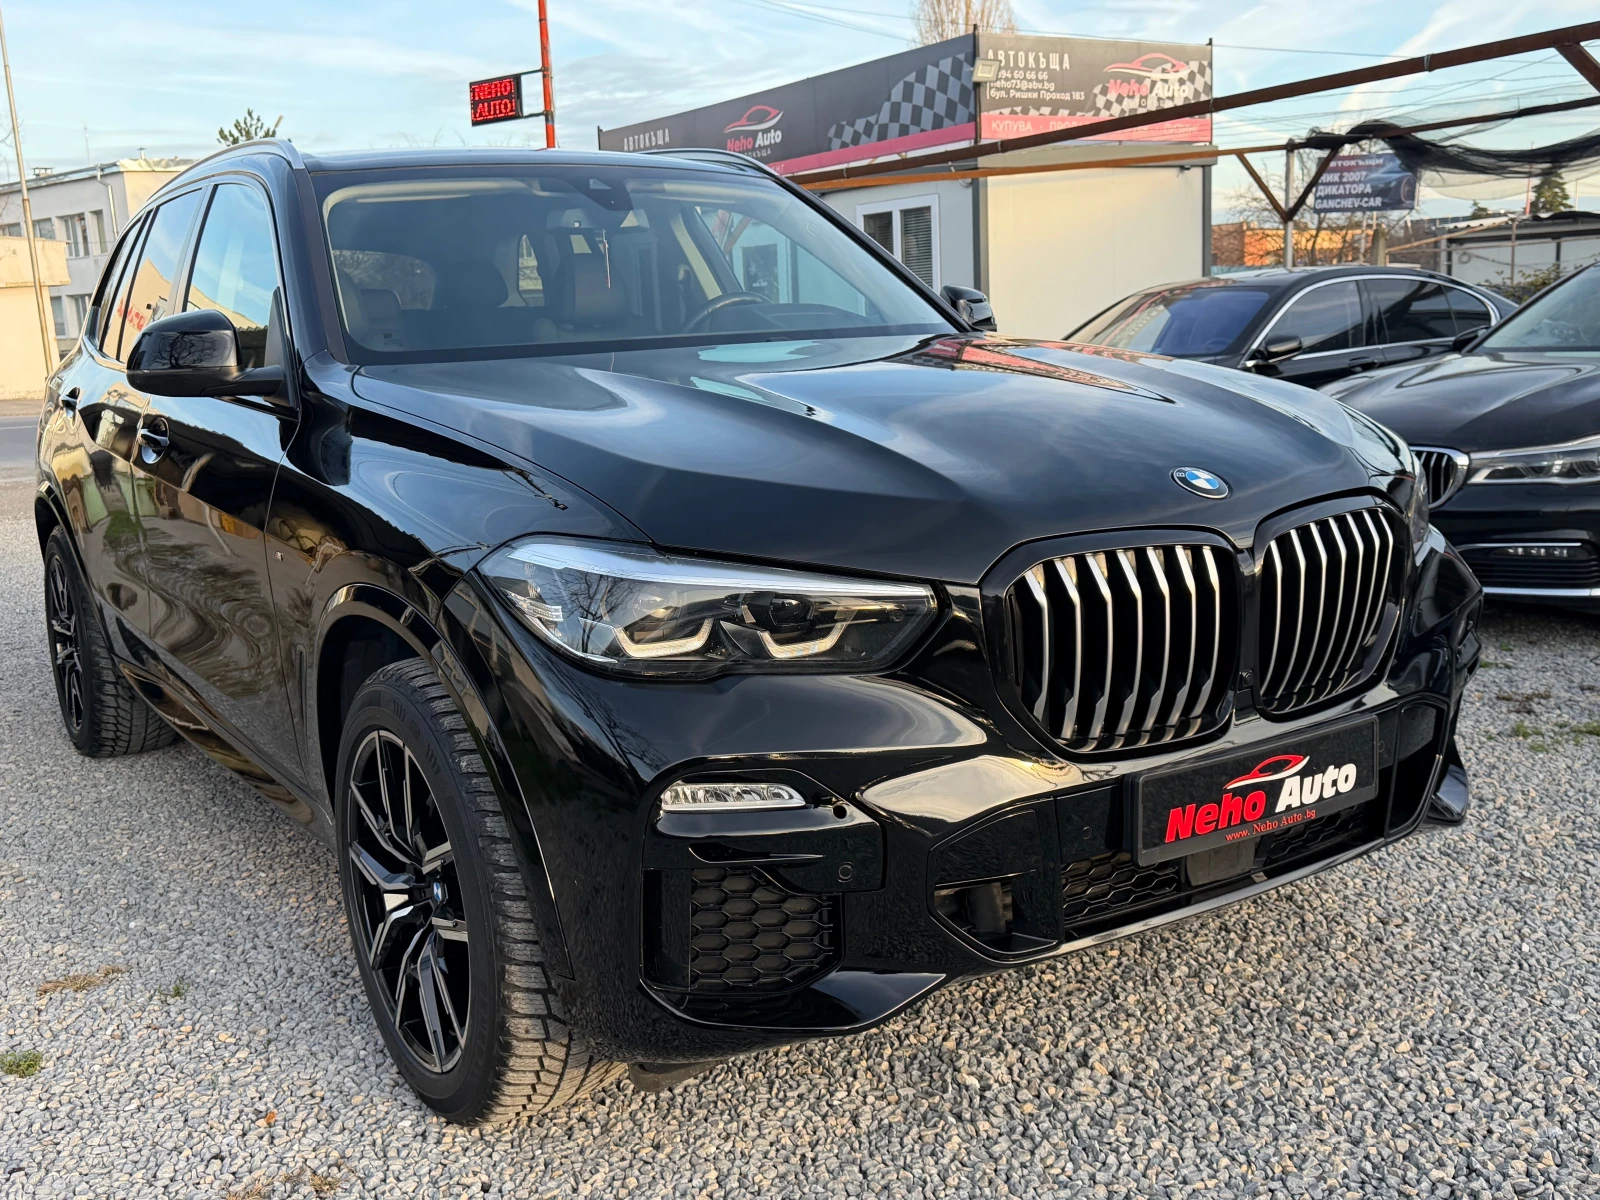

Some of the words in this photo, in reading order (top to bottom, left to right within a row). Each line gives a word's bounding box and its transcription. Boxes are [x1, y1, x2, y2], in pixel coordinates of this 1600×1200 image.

[1013, 70, 1024, 80] 60
[1026, 71, 1037, 80] 66
[1038, 72, 1048, 80] 66
[1108, 79, 1149, 96] Neho
[1151, 81, 1189, 97] Auto
[1010, 90, 1038, 99] Ришки
[1040, 91, 1070, 101] Проход
[1072, 92, 1085, 100] 183
[991, 120, 1032, 132] КУПУВА
[623, 128, 670, 151] АВТОКЪЩА
[727, 135, 753, 153] Neho
[755, 129, 782, 148] Auto
[1342, 172, 1367, 182] 2007
[1316, 184, 1372, 197] ДИКАТОРА
[1315, 197, 1382, 209] GANCHEV-CAR
[1165, 790, 1266, 843] Neho
[1275, 763, 1357, 813] Auto
[1225, 830, 1250, 841] www.
[1252, 820, 1279, 836] Neho
[1280, 812, 1303, 827] Auto
[1304, 808, 1316, 820] .bg
